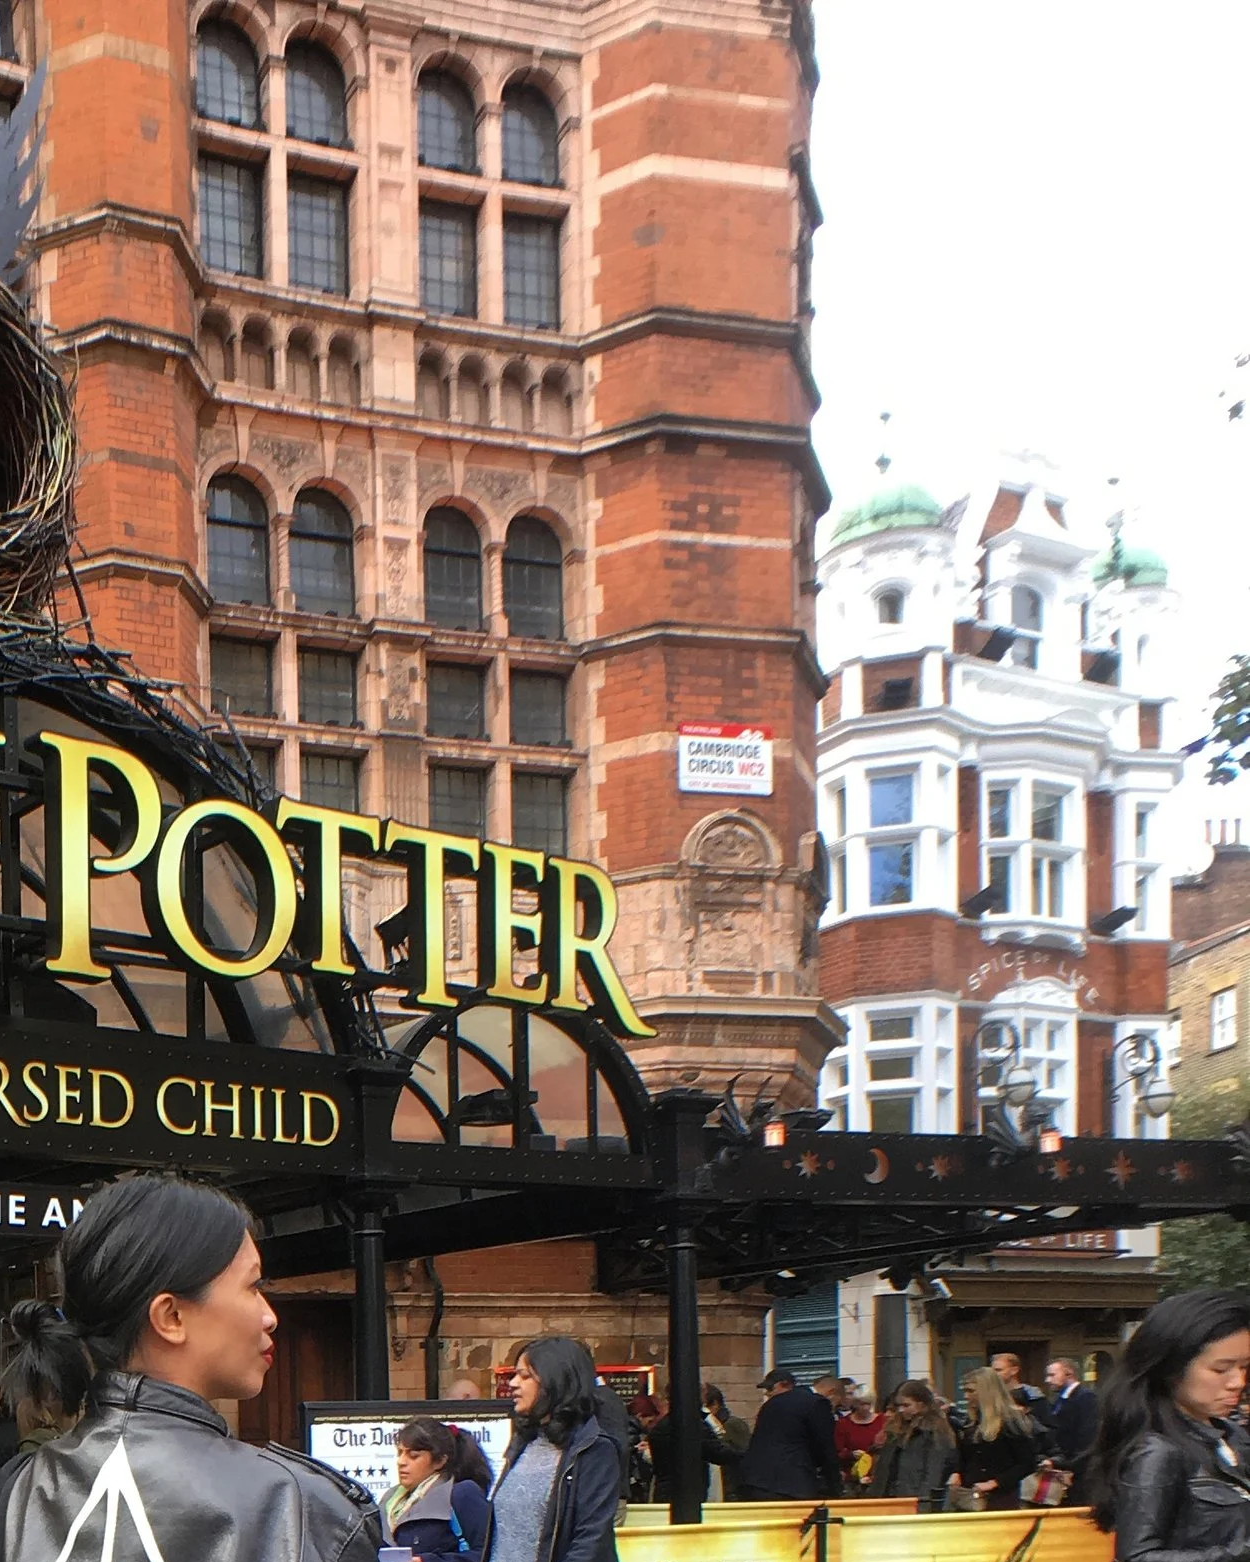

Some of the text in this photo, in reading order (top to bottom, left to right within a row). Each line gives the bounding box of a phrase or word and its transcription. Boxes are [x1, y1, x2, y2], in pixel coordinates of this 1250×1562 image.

[687, 740, 761, 759] CAMBRIDGE
[688, 758, 765, 777] CIRCUS WC2
[37, 729, 659, 1039] POTTER
[968, 950, 1027, 992] SPICE
[156, 1076, 342, 1147] CHILD
[41, 1197, 87, 1229] AN
[1065, 1233, 1107, 1249] LIFE
[333, 1427, 400, 1448] The Dai
